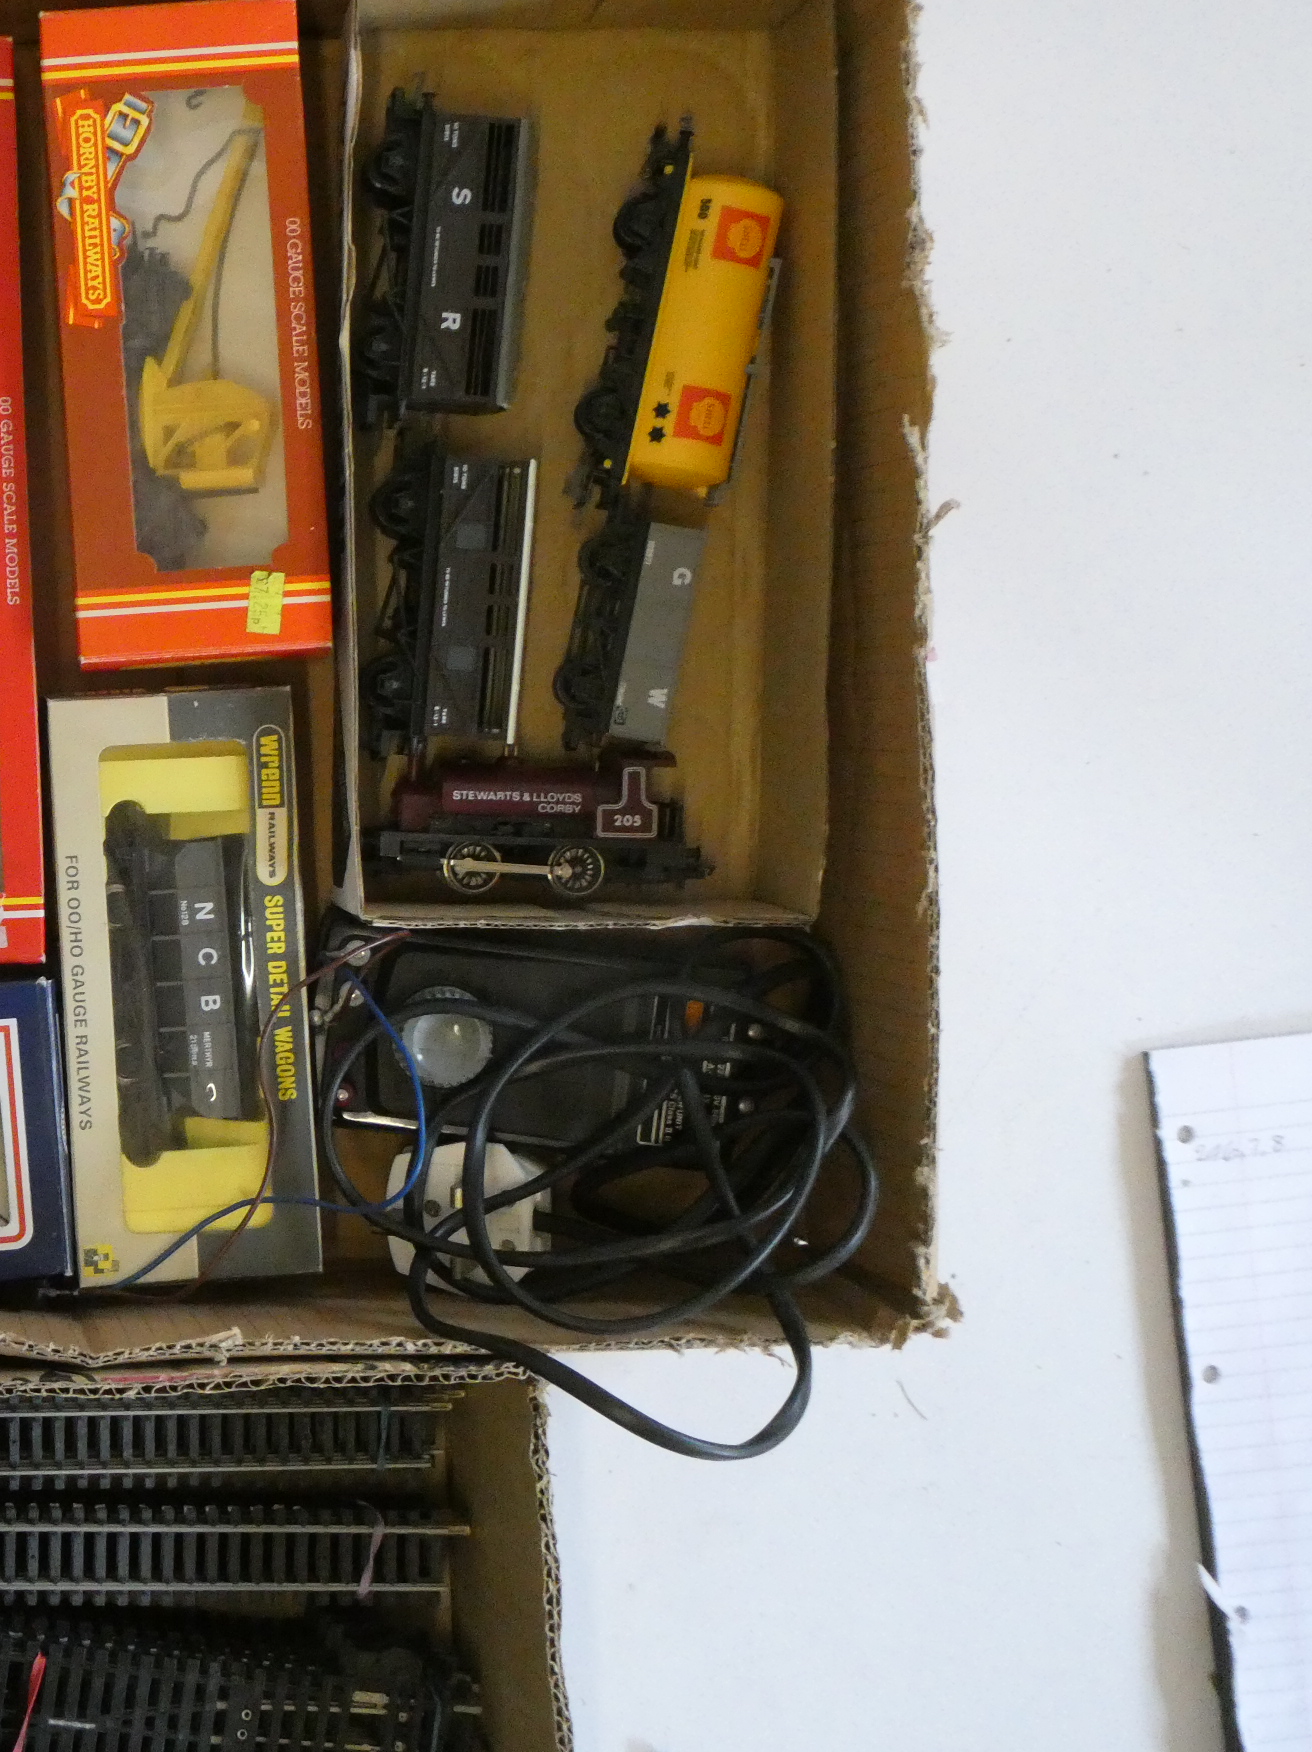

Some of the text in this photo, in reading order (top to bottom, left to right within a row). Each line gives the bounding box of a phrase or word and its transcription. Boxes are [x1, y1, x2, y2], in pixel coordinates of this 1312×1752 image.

[78, 118, 105, 300] HORNBY RAILWAYS
[287, 239, 304, 298] GAUGE
[441, 186, 472, 330] S R
[291, 301, 307, 357] SCALE
[294, 360, 313, 430] MODELS
[0, 420, 15, 478] GAUGE
[3, 482, 17, 533] SCALE
[5, 538, 20, 605] MODELS
[647, 567, 692, 708] G W
[452, 790, 582, 803] STEWARTS & LLOYDS
[538, 803, 581, 813] CORBY
[613, 815, 642, 827] 205
[65, 855, 80, 891] FOR
[268, 812, 277, 879] RAILWAYS
[194, 902, 215, 920] N
[263, 894, 286, 955] SUPER
[198, 948, 218, 965] C
[71, 964, 88, 1028] GAUGE
[200, 995, 221, 1011] B
[75, 1035, 92, 1131] RAILWAYS
[273, 1026, 297, 1102] WAGONS
